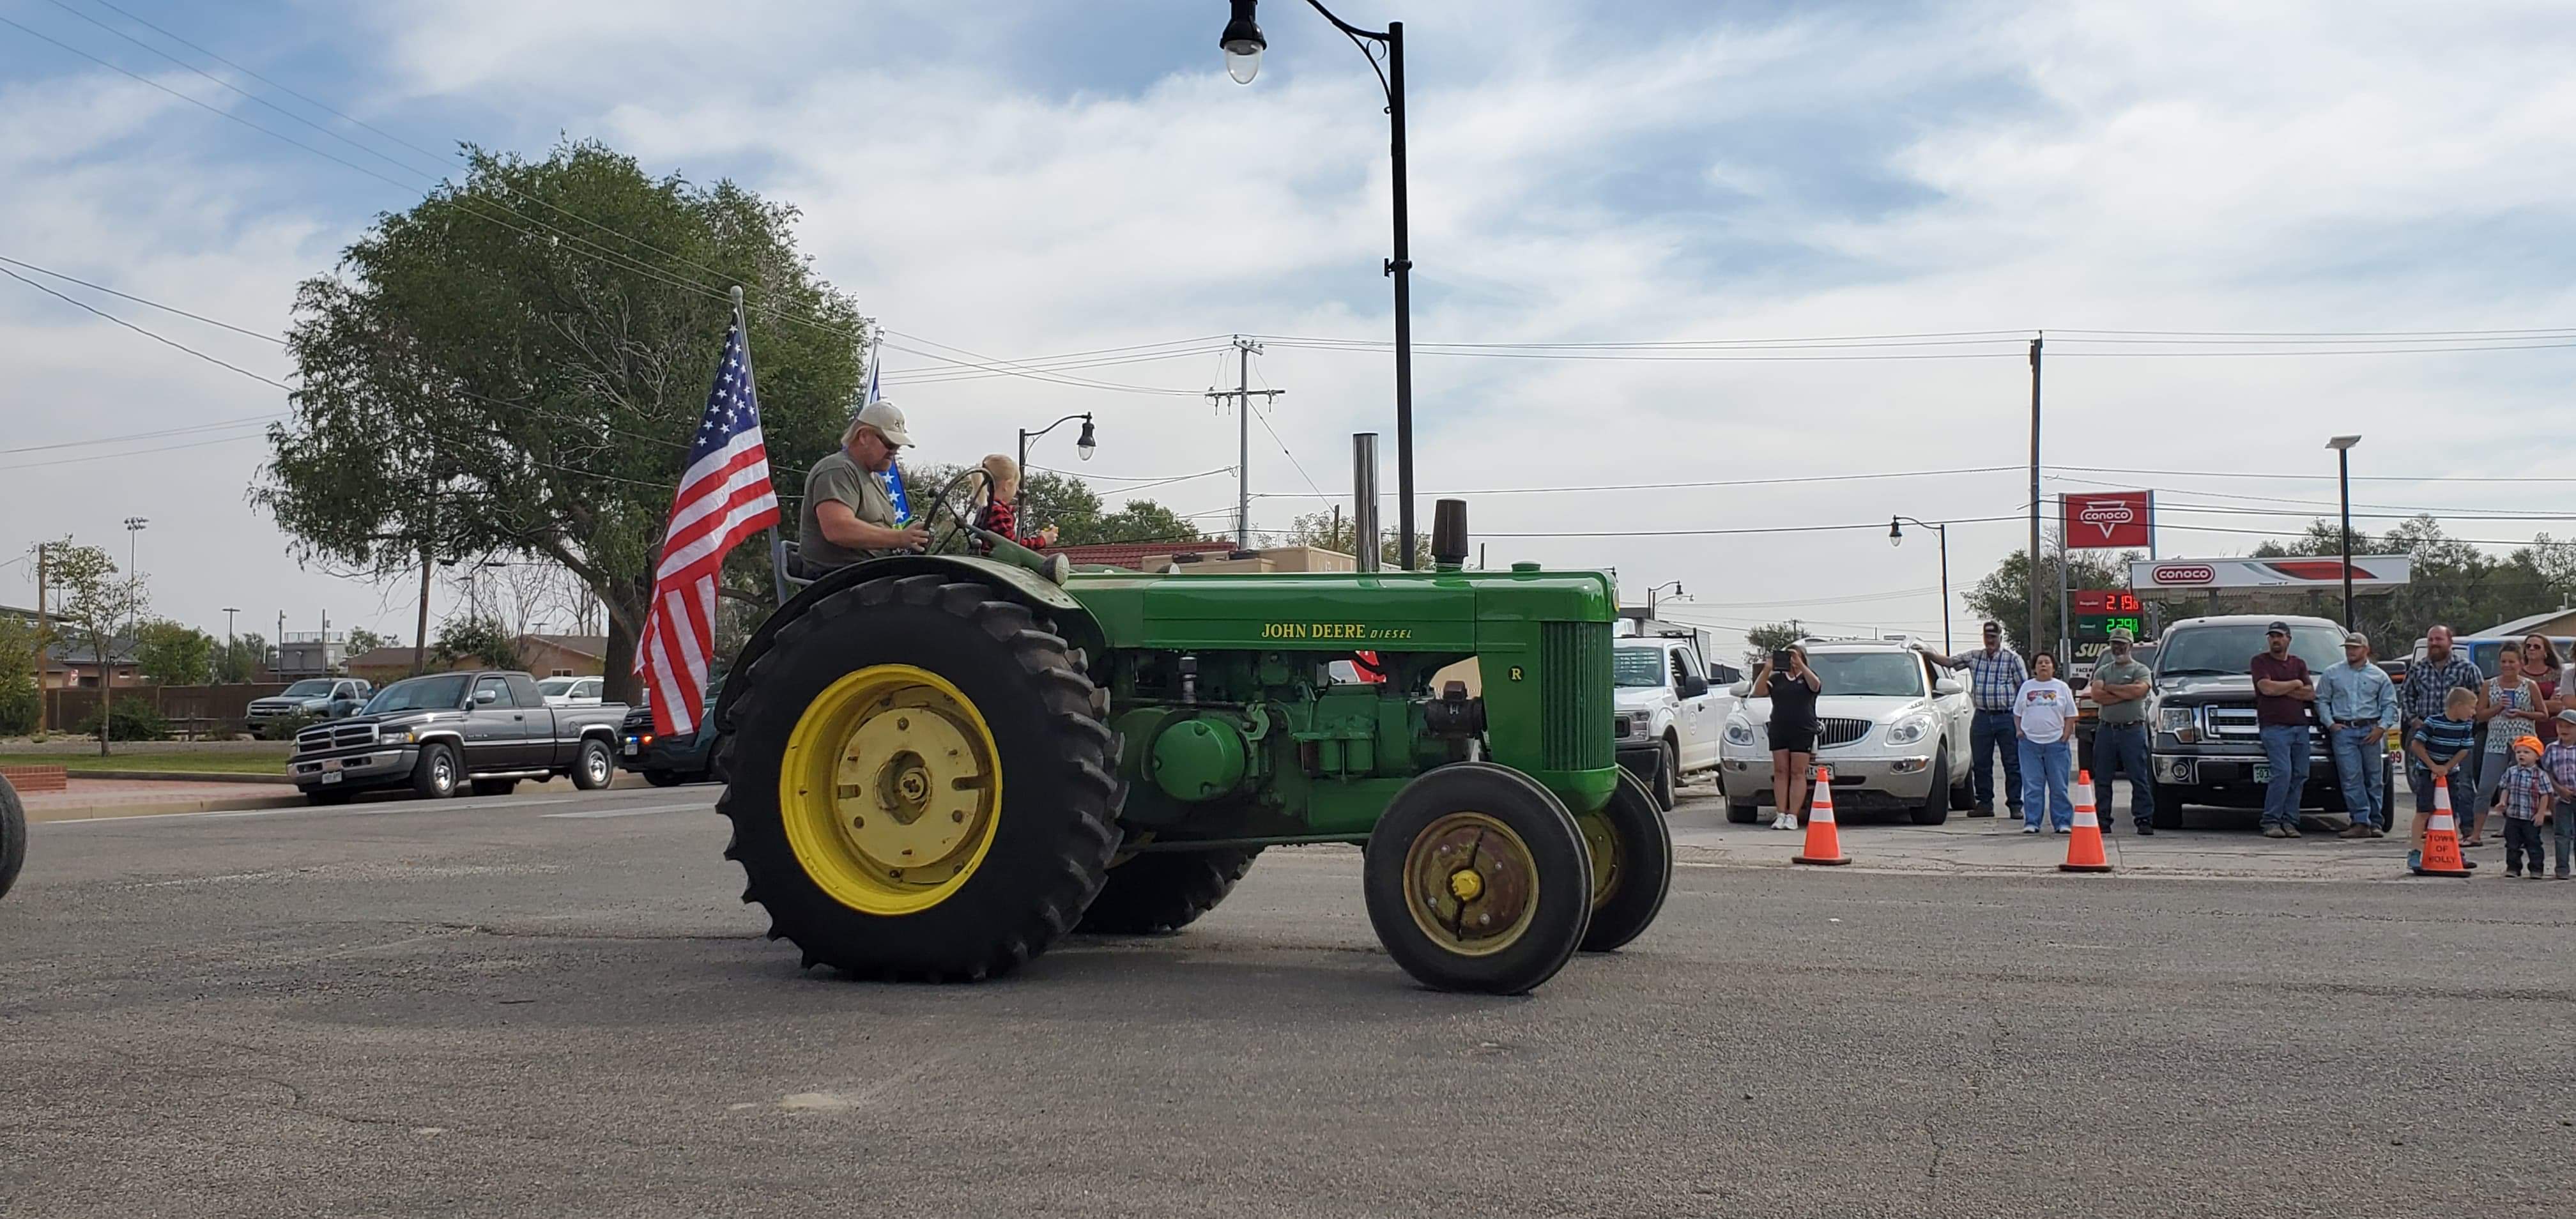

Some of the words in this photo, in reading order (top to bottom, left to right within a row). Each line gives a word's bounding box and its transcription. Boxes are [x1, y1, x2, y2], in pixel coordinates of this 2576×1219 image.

[1261, 623, 1307, 638] JOHN
[1312, 624, 1365, 638] DEERE
[1370, 629, 1412, 638] DIESEL
[1511, 668, 1522, 680] R
